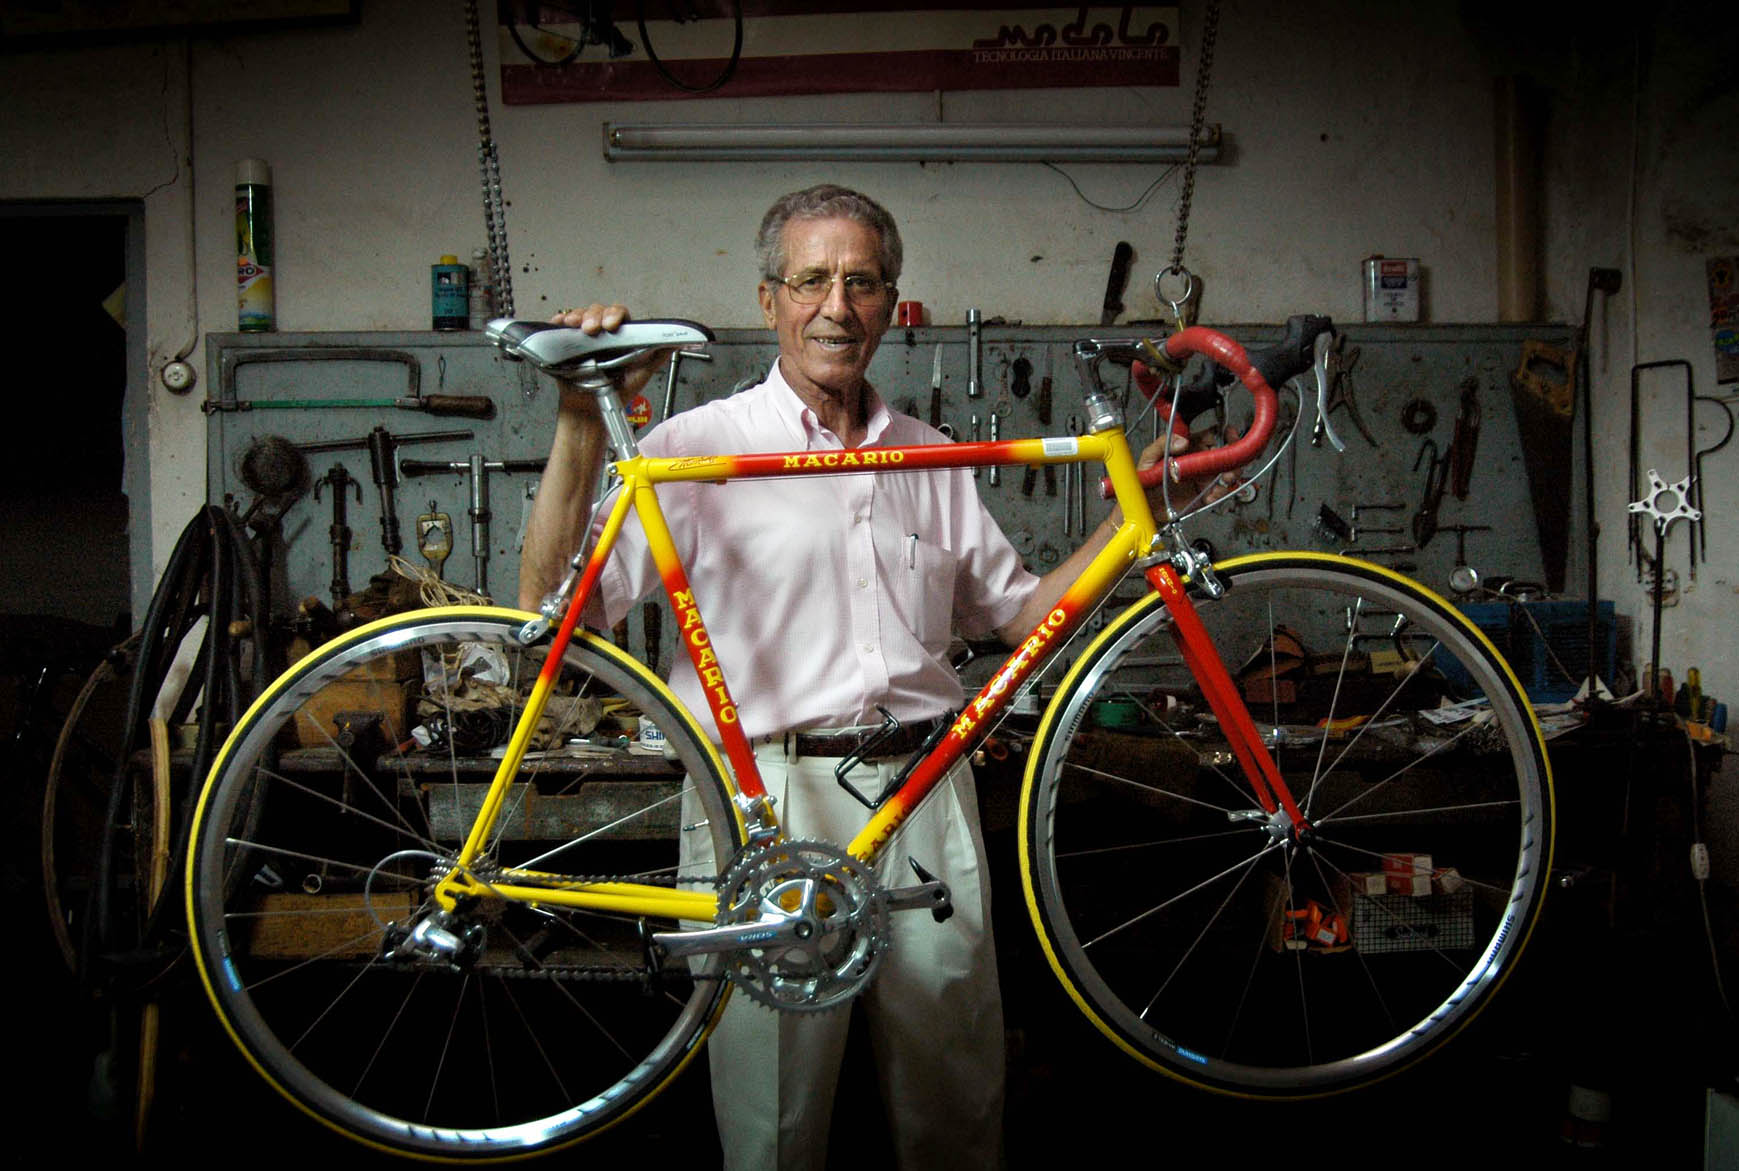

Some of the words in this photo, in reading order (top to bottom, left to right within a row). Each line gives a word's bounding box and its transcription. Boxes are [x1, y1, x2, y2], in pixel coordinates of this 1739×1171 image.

[974, 49, 1048, 63] TECNOLOGIA
[1051, 48, 1109, 62] ITALIANA
[783, 450, 905, 468] MACARIO
[673, 588, 737, 724] MACARIO
[951, 608, 1066, 740] MACARIO
